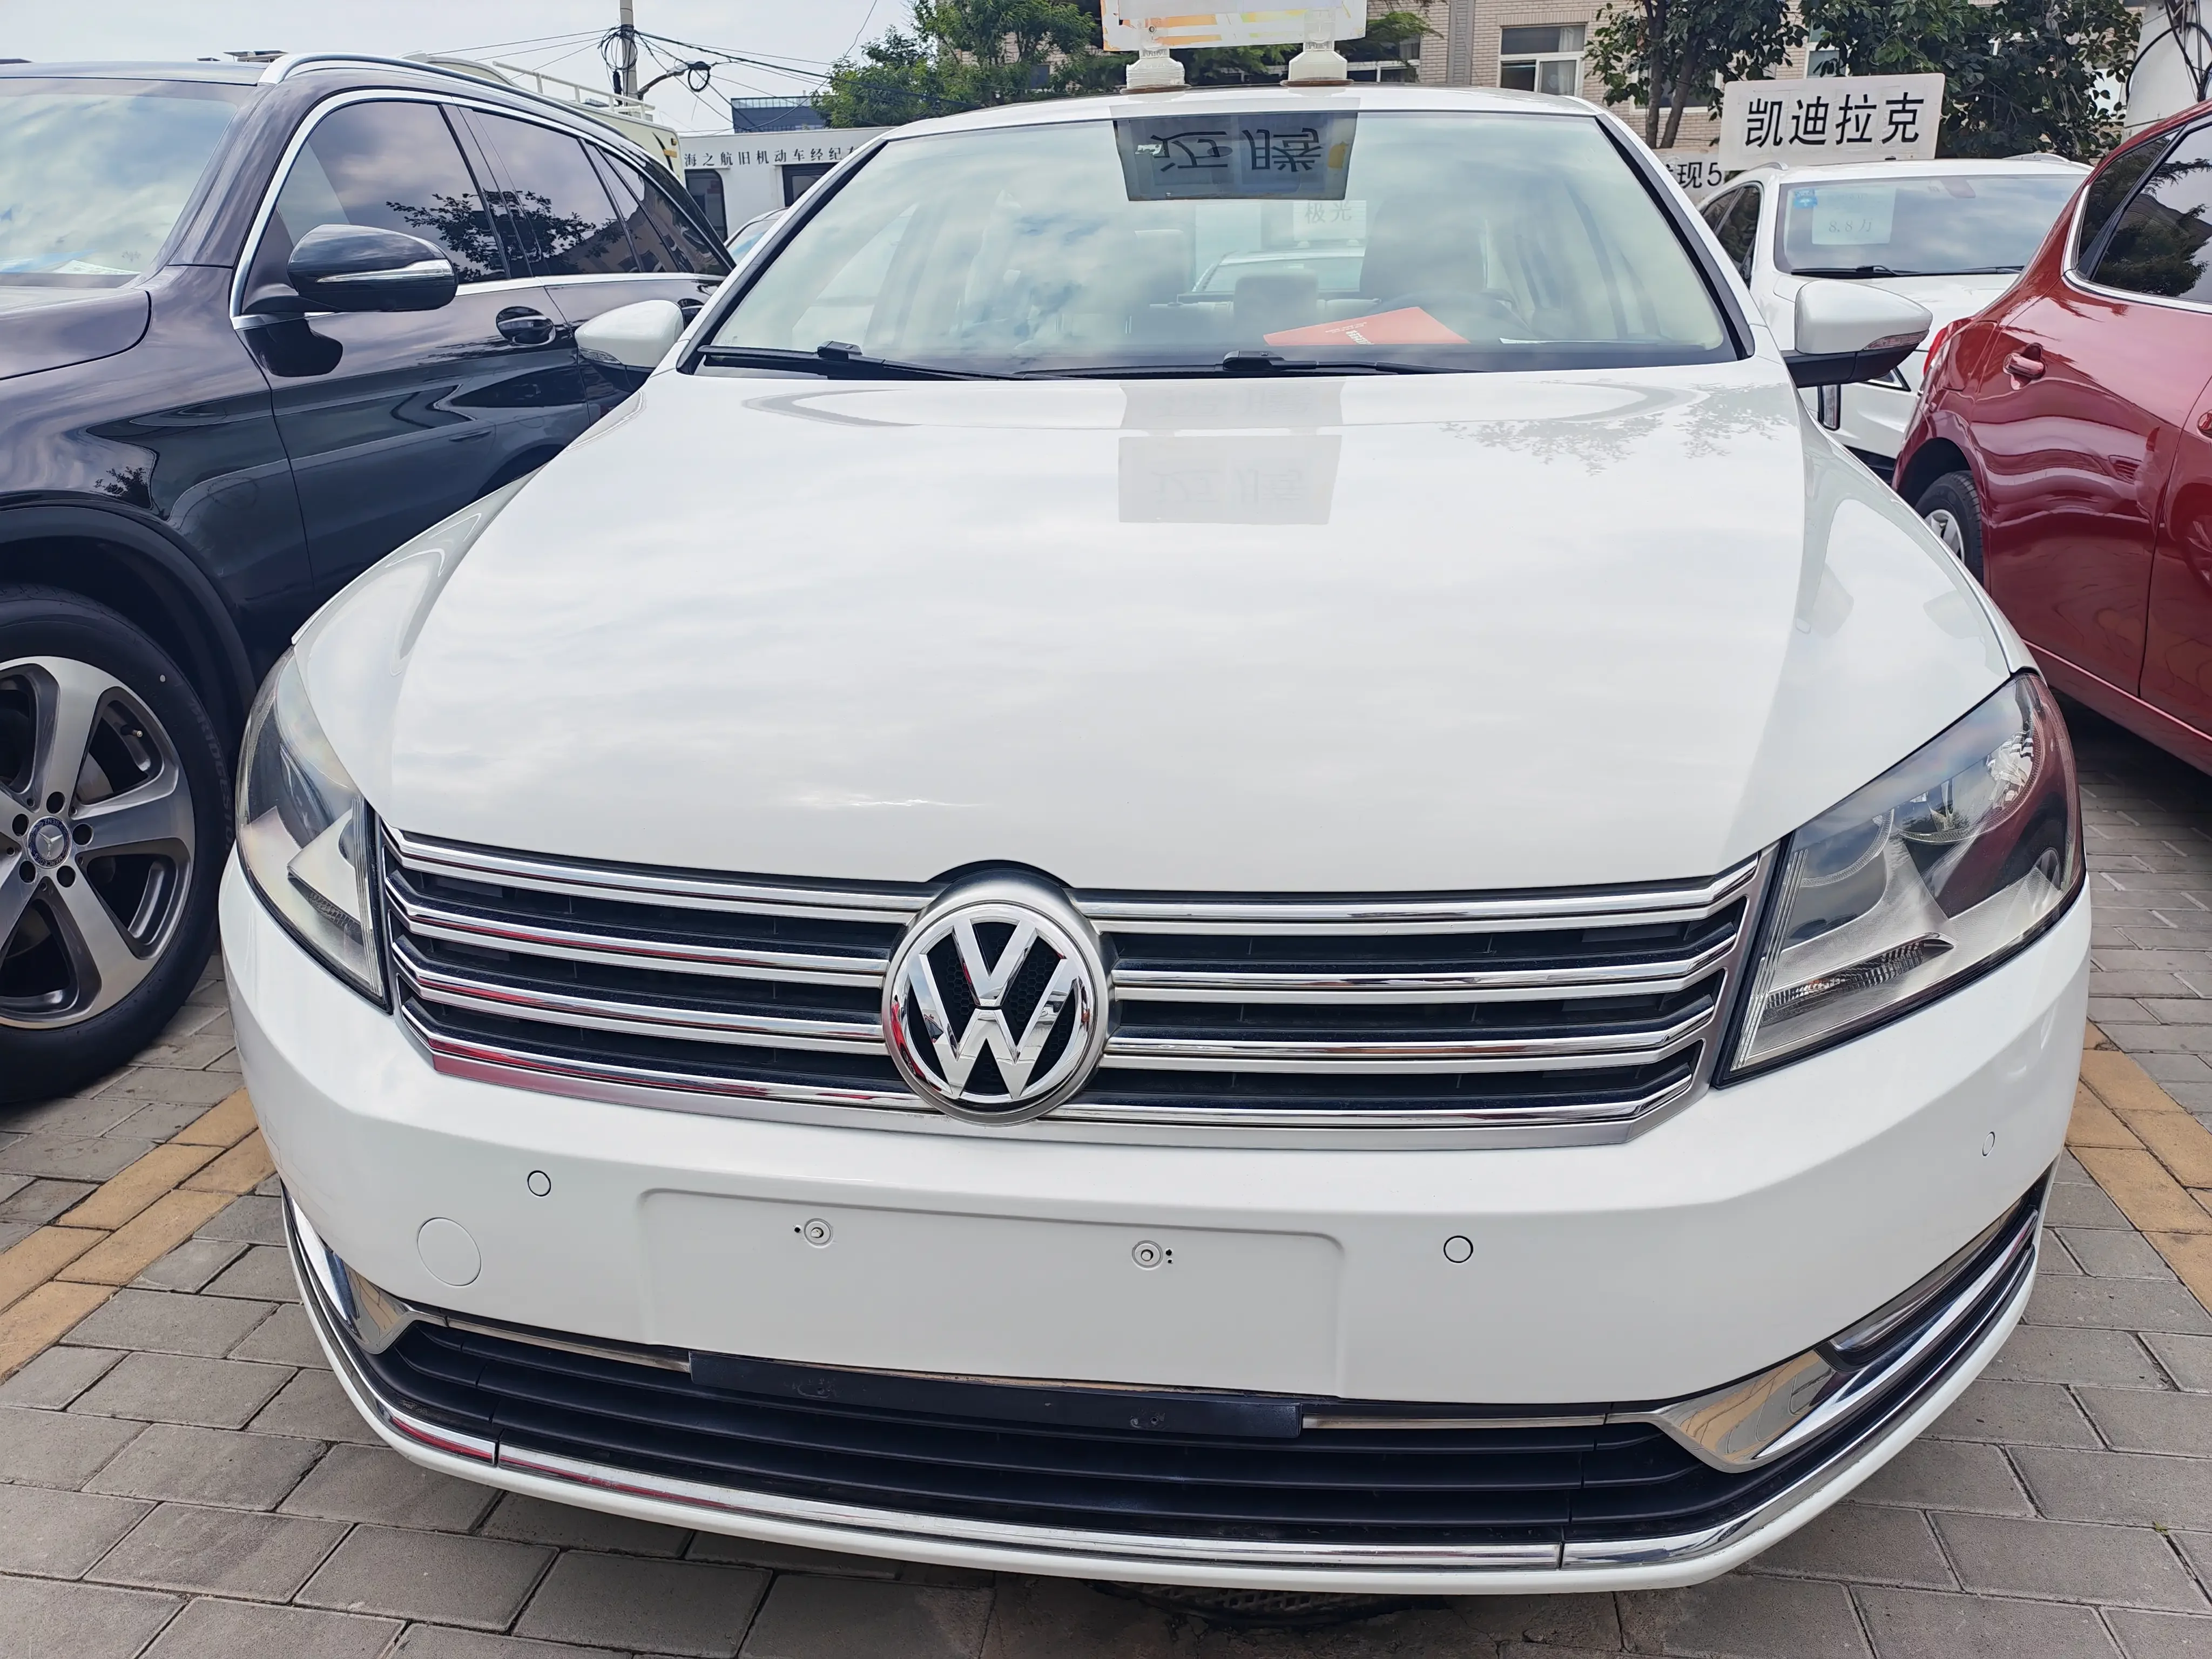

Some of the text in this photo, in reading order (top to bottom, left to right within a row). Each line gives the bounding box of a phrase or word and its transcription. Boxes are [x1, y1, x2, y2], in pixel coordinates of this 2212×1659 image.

[1744, 92, 1925, 148] 凯迪拉克
[1665, 161, 1722, 188] 现5
[1304, 201, 1352, 224] 极光
[187, 697, 234, 851] BRIDGESTO
[43, 818, 60, 826] BENZ
[33, 853, 64, 867] MERCEDES
[904, 914, 1082, 1101] VW
